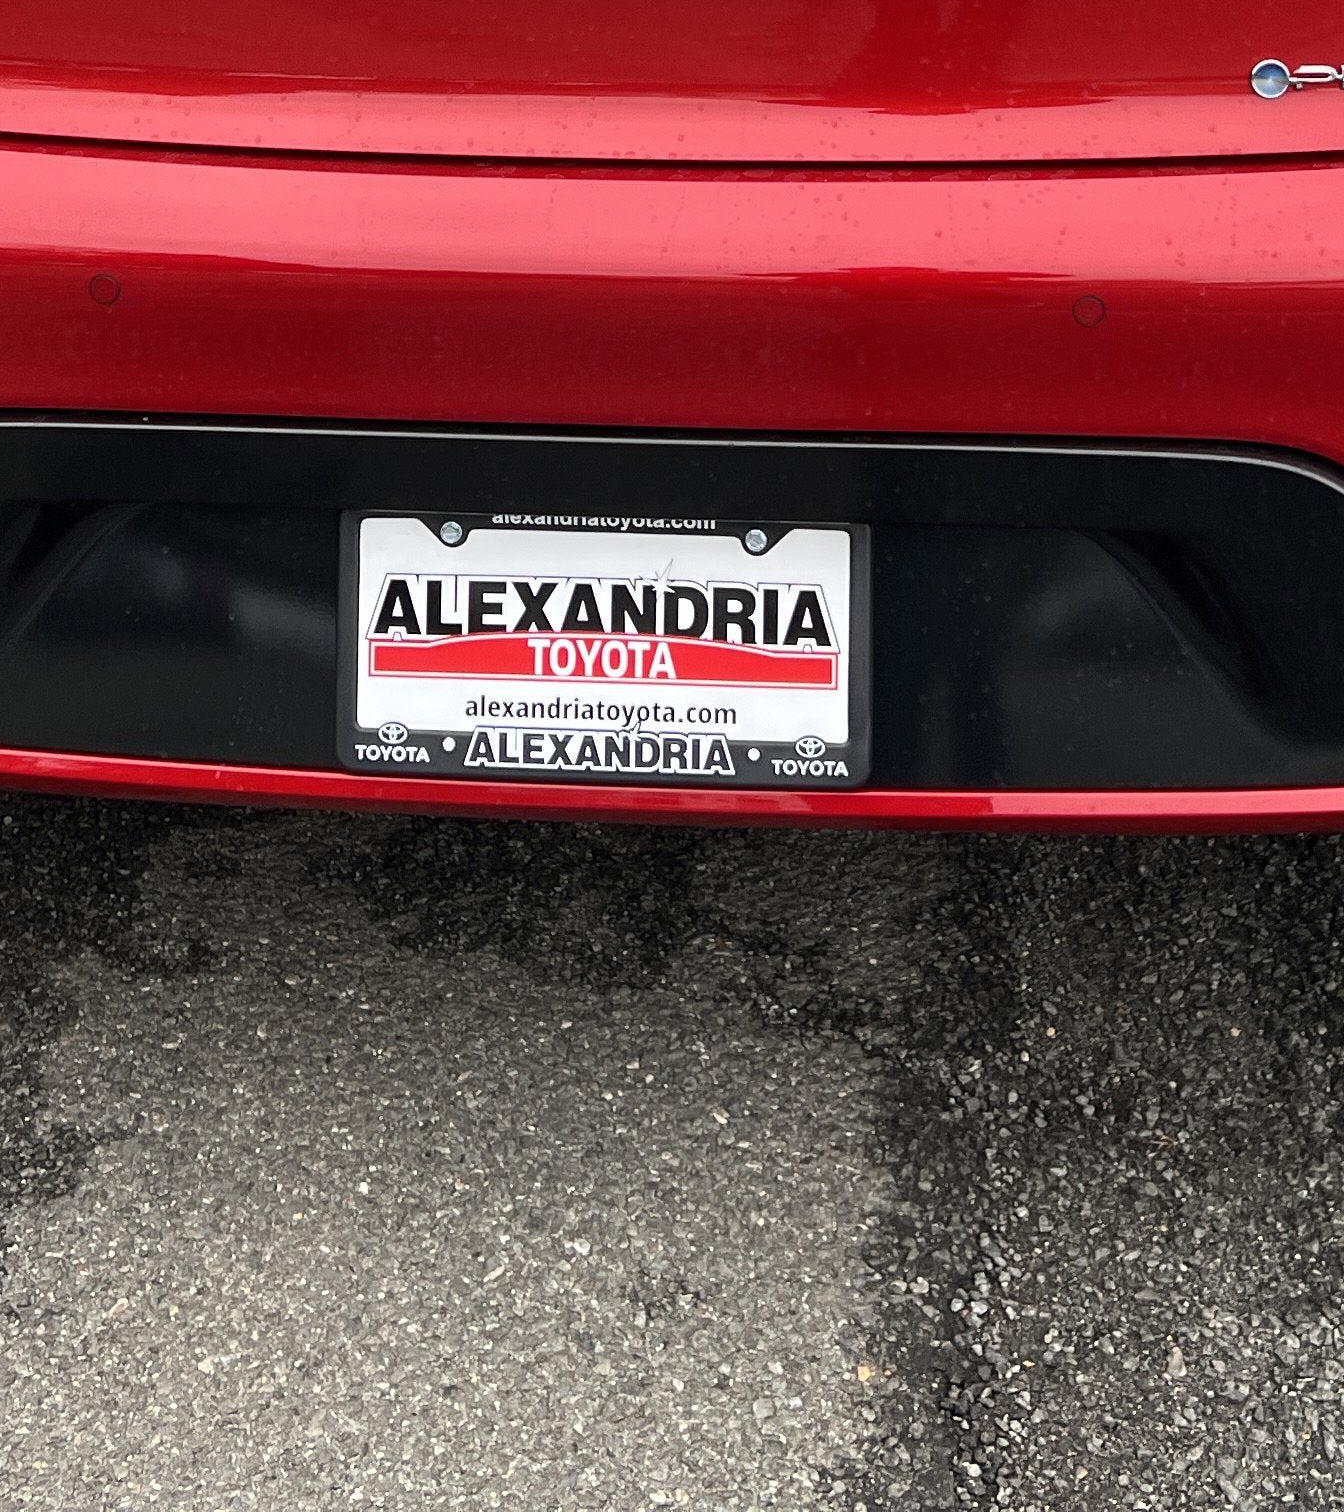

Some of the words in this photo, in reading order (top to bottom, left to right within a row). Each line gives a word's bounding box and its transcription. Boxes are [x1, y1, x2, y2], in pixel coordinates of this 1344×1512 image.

[373, 578, 832, 647] ALEXANDRIA
[526, 638, 678, 680] TOYOTA
[464, 694, 738, 728] alexandriatoyota.com
[354, 743, 431, 764] TOYOTA
[463, 726, 736, 776] ALEXANDRIA
[770, 758, 850, 778] TOYOTA
